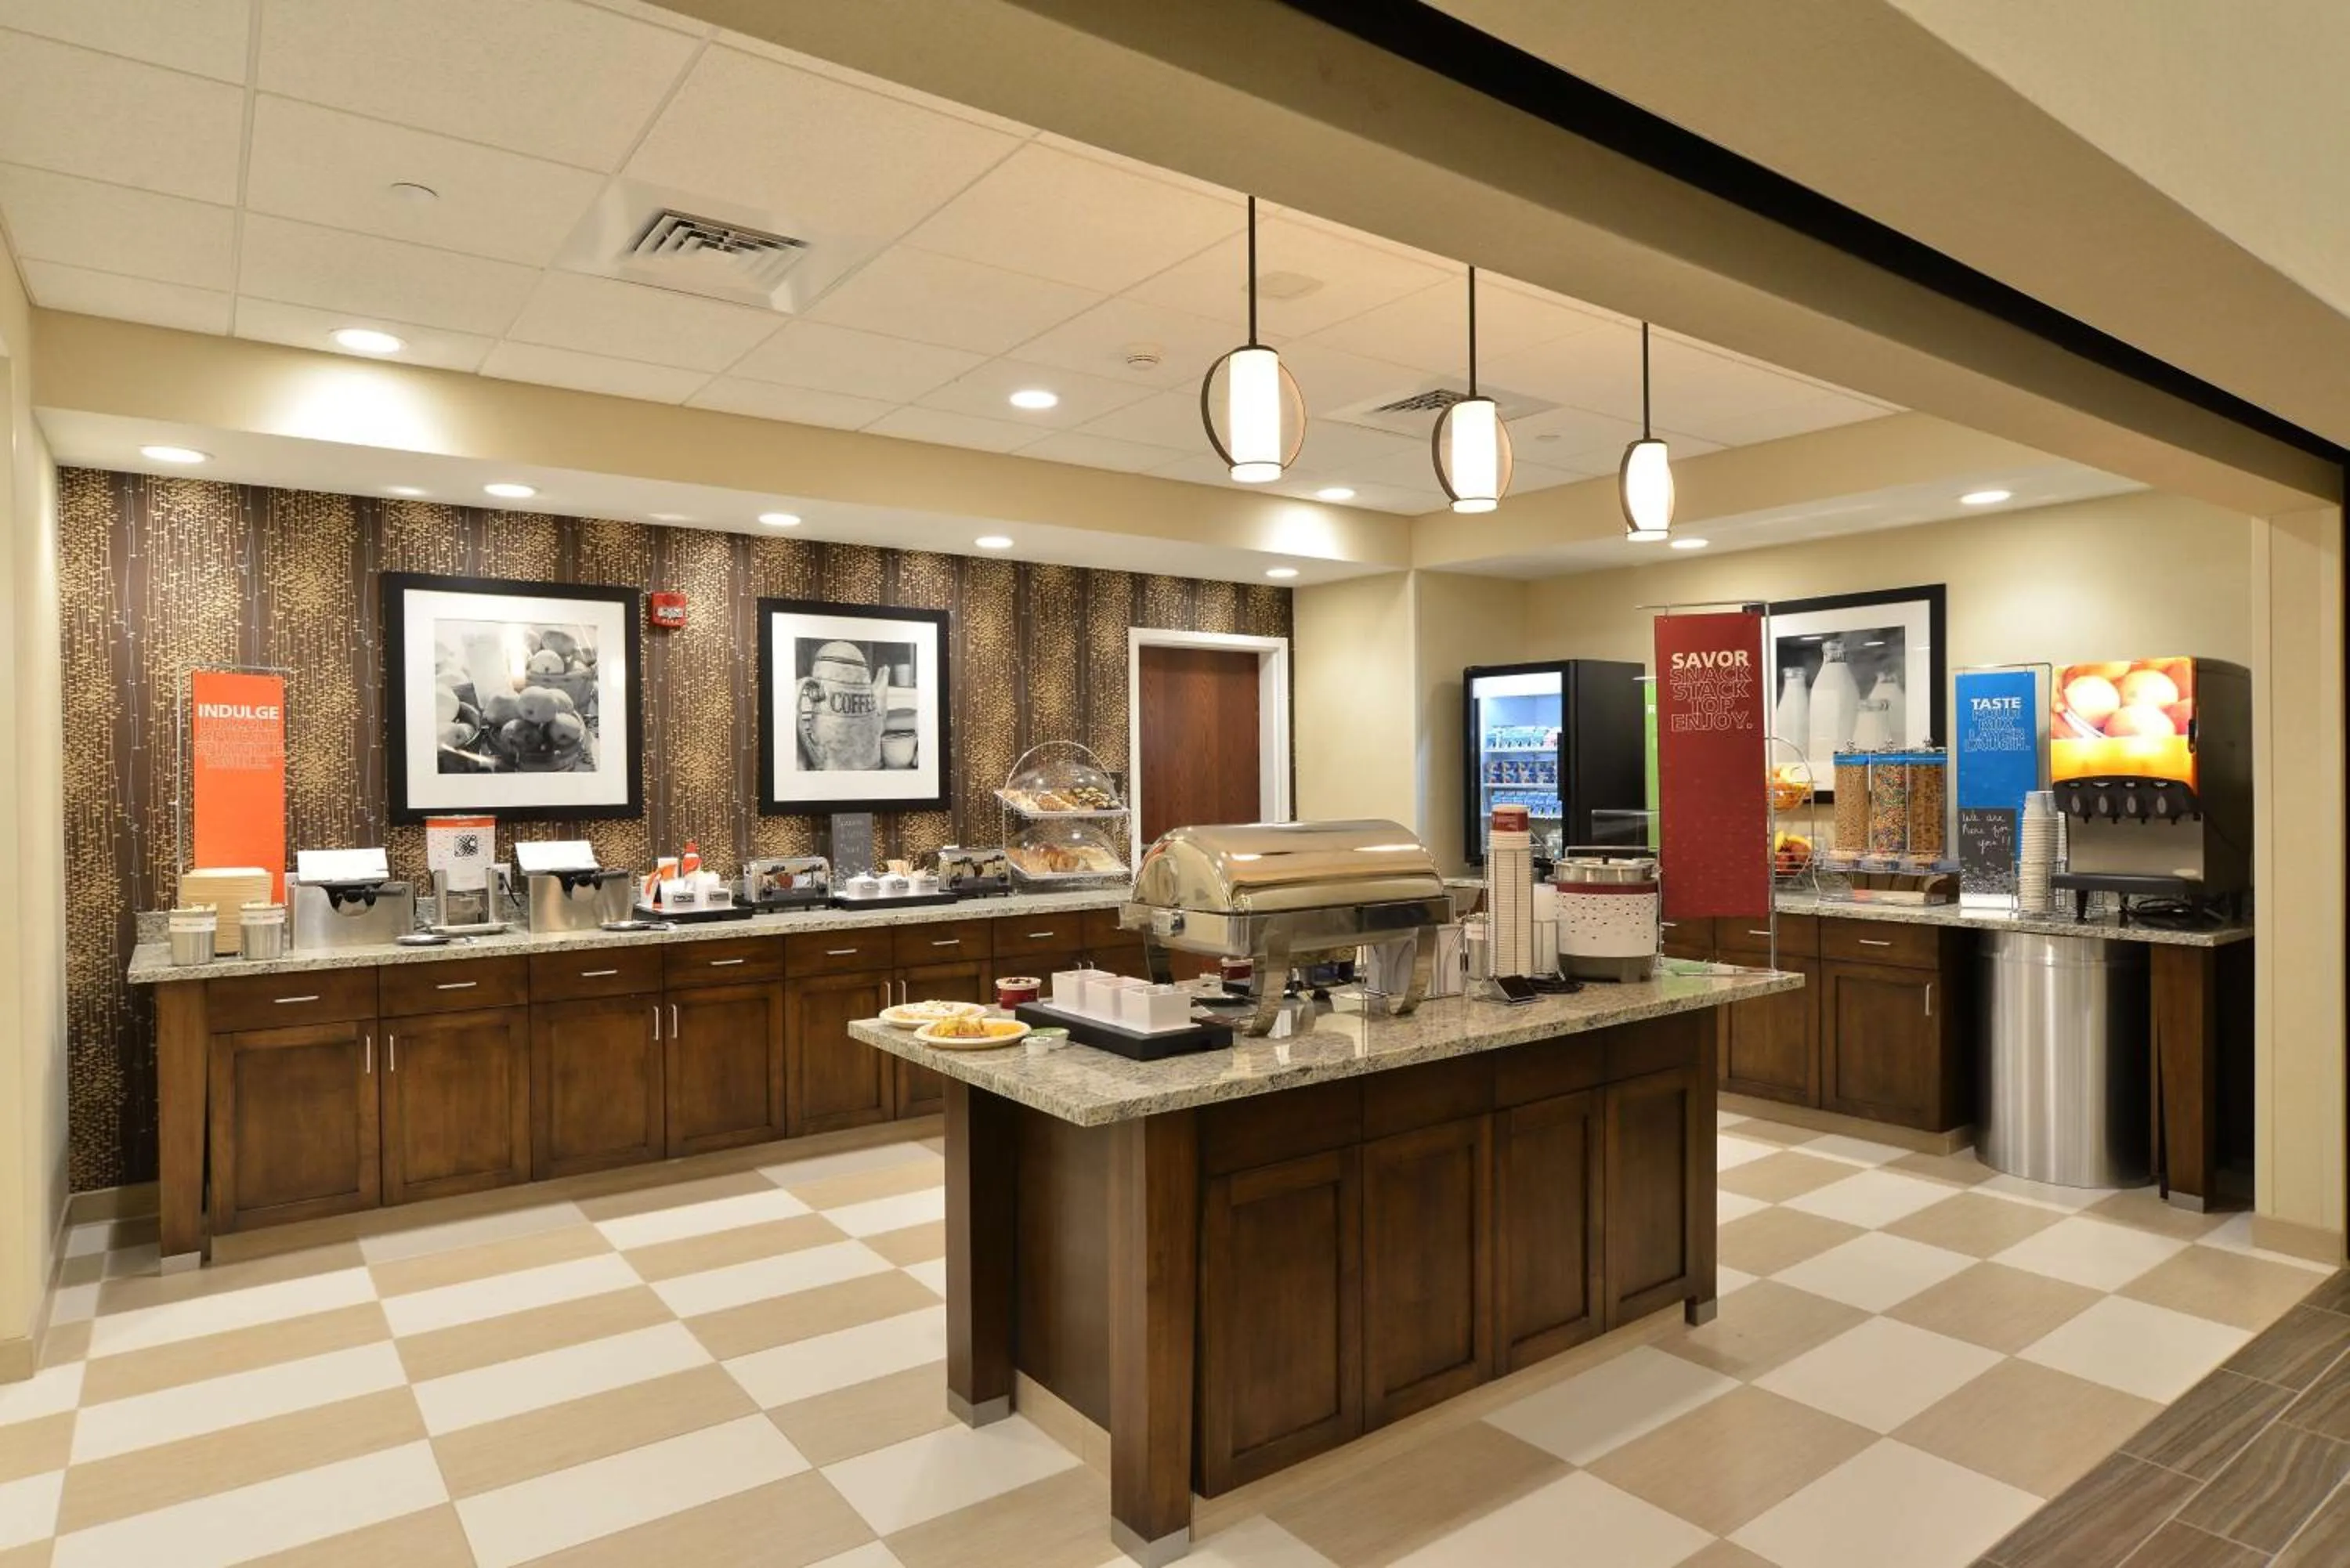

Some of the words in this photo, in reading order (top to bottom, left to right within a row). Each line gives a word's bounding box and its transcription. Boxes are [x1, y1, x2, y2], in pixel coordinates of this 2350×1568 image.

[1671, 649, 1749, 670] SAVOR
[1669, 664, 1752, 685] SNACK
[1672, 680, 1750, 701] STACK
[198, 703, 280, 720] INDULGE
[1687, 696, 1734, 715] TOP
[1970, 696, 2023, 710] TASTE
[1671, 710, 1754, 732] ENJOY.
[1978, 717, 2015, 732] MIX
